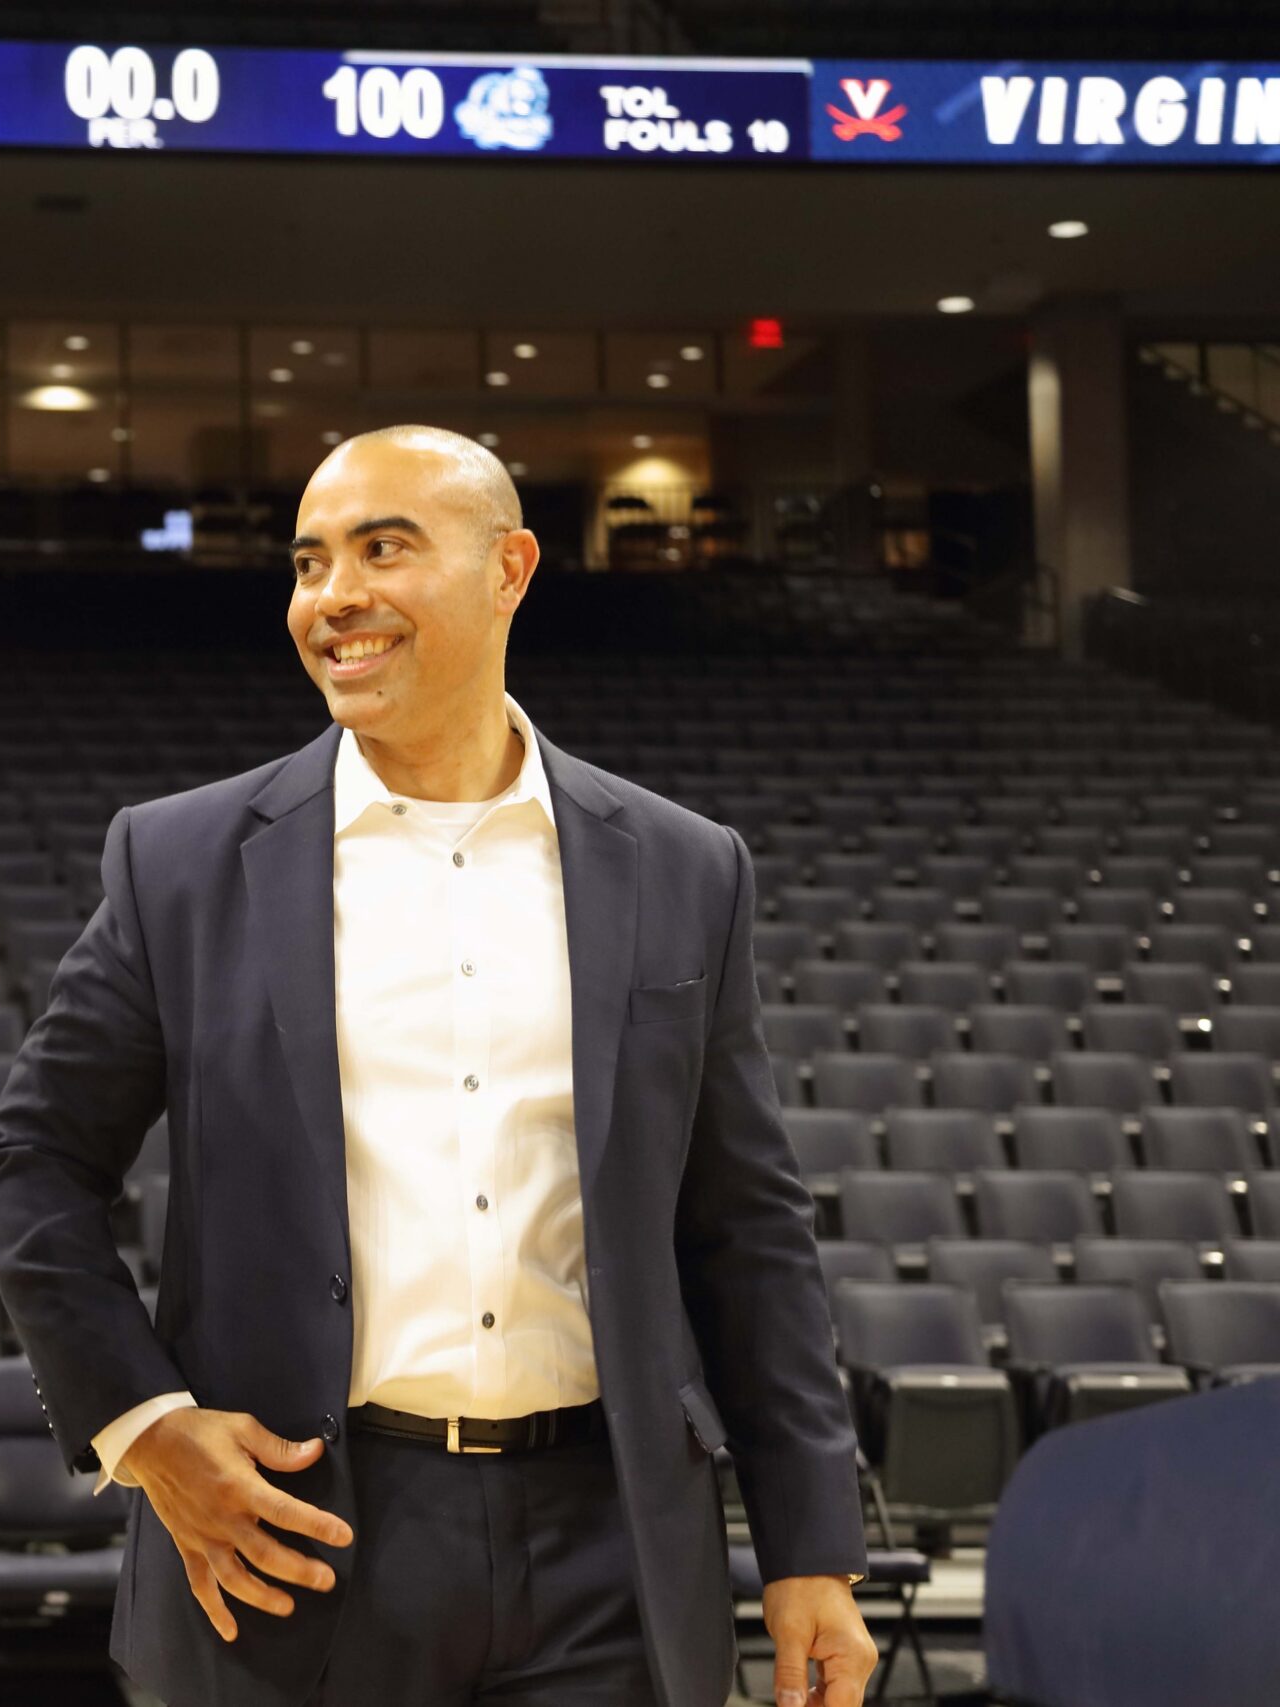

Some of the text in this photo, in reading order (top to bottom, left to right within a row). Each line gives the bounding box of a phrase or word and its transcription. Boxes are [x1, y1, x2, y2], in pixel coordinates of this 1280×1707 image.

[64, 45, 219, 123] 00.0
[322, 66, 444, 139] 100
[980, 75, 1280, 146] VIRGIN
[603, 118, 789, 153] FOULS 10
